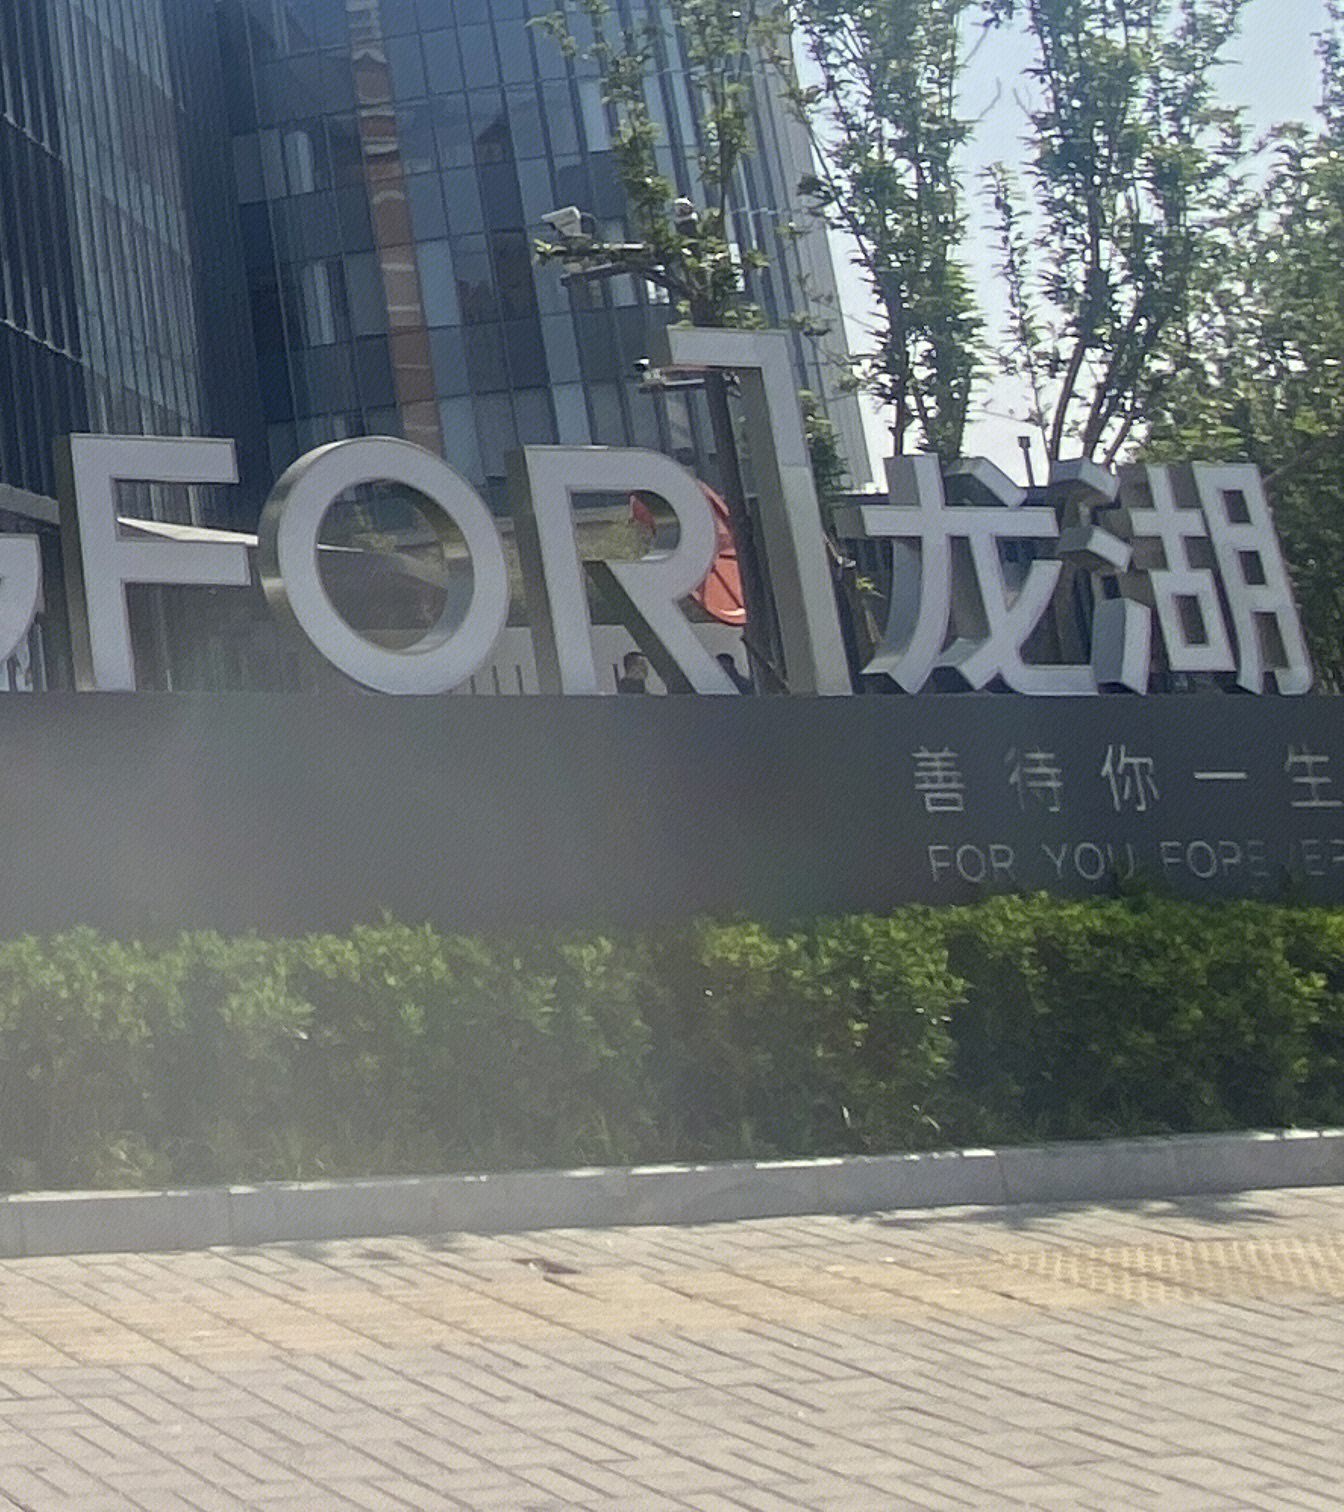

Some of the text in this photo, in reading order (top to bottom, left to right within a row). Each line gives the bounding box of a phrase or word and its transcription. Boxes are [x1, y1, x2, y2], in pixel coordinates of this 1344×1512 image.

[854, 451, 1313, 697] 龙湖
[911, 744, 1343, 813] 善待你一生
[927, 843, 1015, 883] FOR
[1041, 841, 1137, 881] YOU
